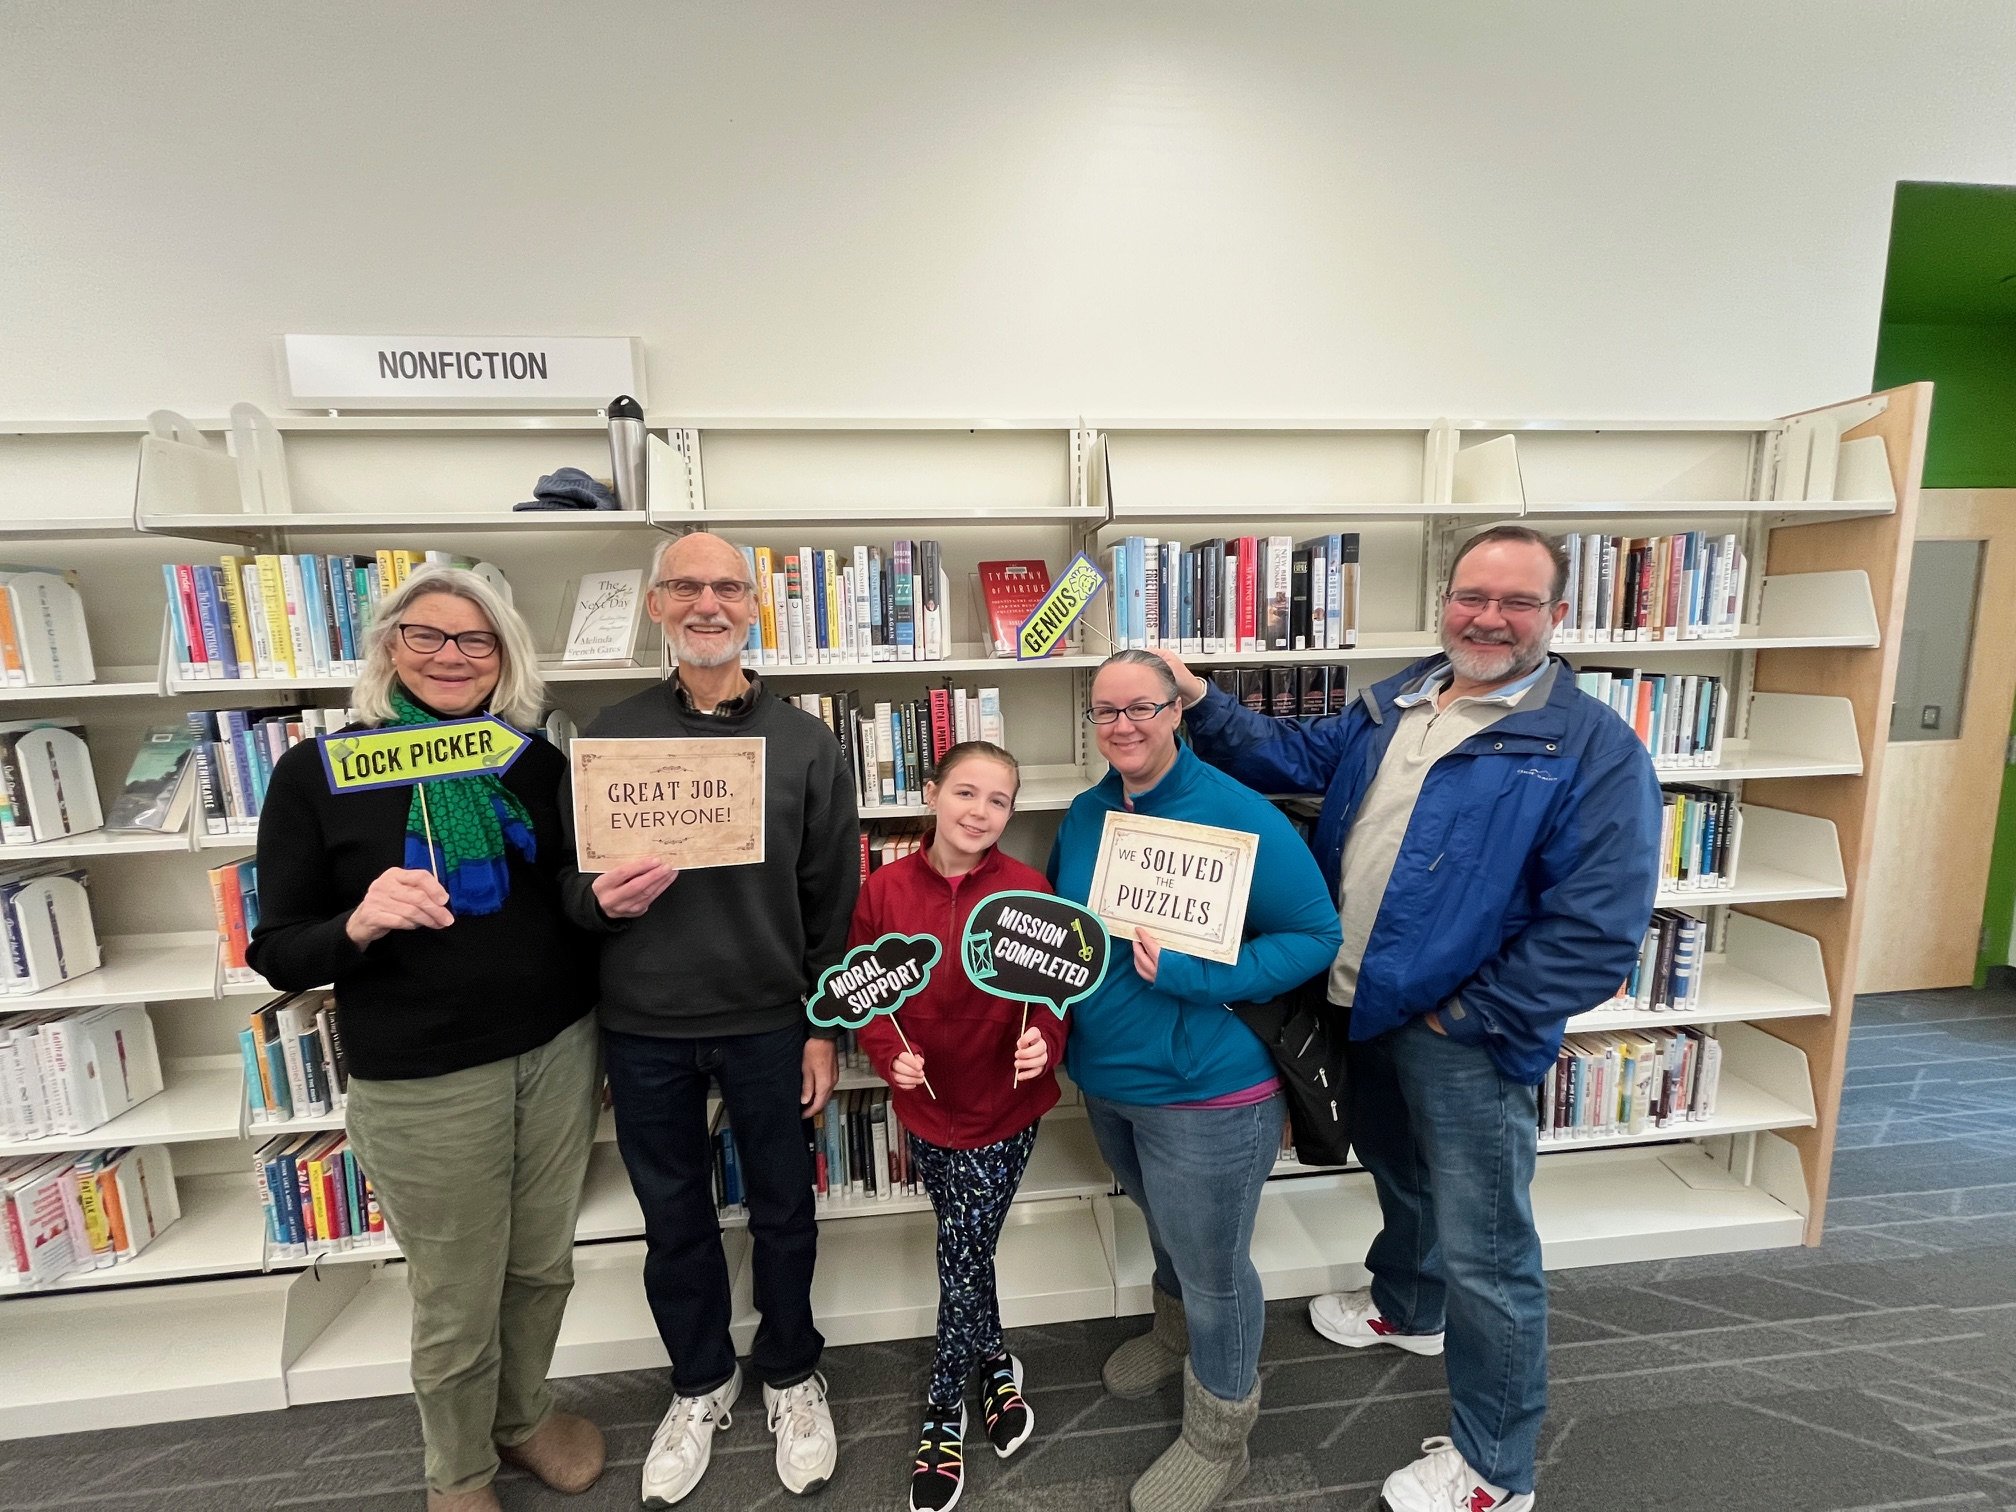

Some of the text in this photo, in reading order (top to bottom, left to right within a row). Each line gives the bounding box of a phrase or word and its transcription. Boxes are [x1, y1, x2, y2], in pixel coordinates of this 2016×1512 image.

[378, 350, 548, 380] NONFICTION
[380, 557, 388, 582] Good
[827, 555, 835, 587] Gaslighting
[857, 551, 866, 594] FRIENDSHIP
[1280, 549, 1288, 567] NEW
[1601, 541, 1611, 581] ZEALOT
[1723, 541, 1733, 591] BILLY GRAHAM
[180, 569, 191, 593] under
[344, 557, 352, 568] The
[348, 592, 357, 614] Solution
[599, 581, 619, 591] The
[897, 584, 911, 594] 77
[988, 571, 1041, 581] TYRANNY
[1005, 584, 1046, 593] VIRTUE
[200, 602, 212, 621] Dance
[609, 598, 629, 609] Day
[1145, 568, 1159, 629] FREETHINKERS
[1245, 567, 1253, 630] MAKING BIBLE
[1024, 587, 1077, 653] GENIUS
[205, 627, 219, 660] INTIMACY
[294, 627, 302, 653] DRUNK
[568, 646, 622, 656] French Gates
[580, 635, 613, 645] Melinda
[935, 692, 948, 762] MEDICAL APARTHE
[342, 729, 493, 782] LOCK PICKER
[196, 754, 215, 809] UNTHINKABLE
[608, 780, 680, 805] GREAT
[611, 807, 731, 829] EVERYONE!
[1119, 847, 1224, 883] WE SOLVED
[1155, 876, 1175, 889] THE
[1117, 884, 1211, 925] PUZZLES
[997, 905, 1069, 949] MISSION
[828, 955, 888, 999] MORAL
[994, 936, 1090, 989] COMPLETED
[847, 958, 922, 1015] SUPPORT
[327, 1011, 337, 1034] Loving
[332, 1033, 342, 1052] What
[51, 1031, 67, 1073] Antifragile
[288, 1046, 301, 1083] Liberated
[295, 1084, 304, 1104] Mind
[254, 1157, 270, 1202] LOVE LIFE
[280, 1159, 289, 1176] THINK
[282, 1177, 290, 1189] LIKE
[297, 1169, 310, 1194] 24/6
[81, 1180, 95, 1214] FAT TALK
